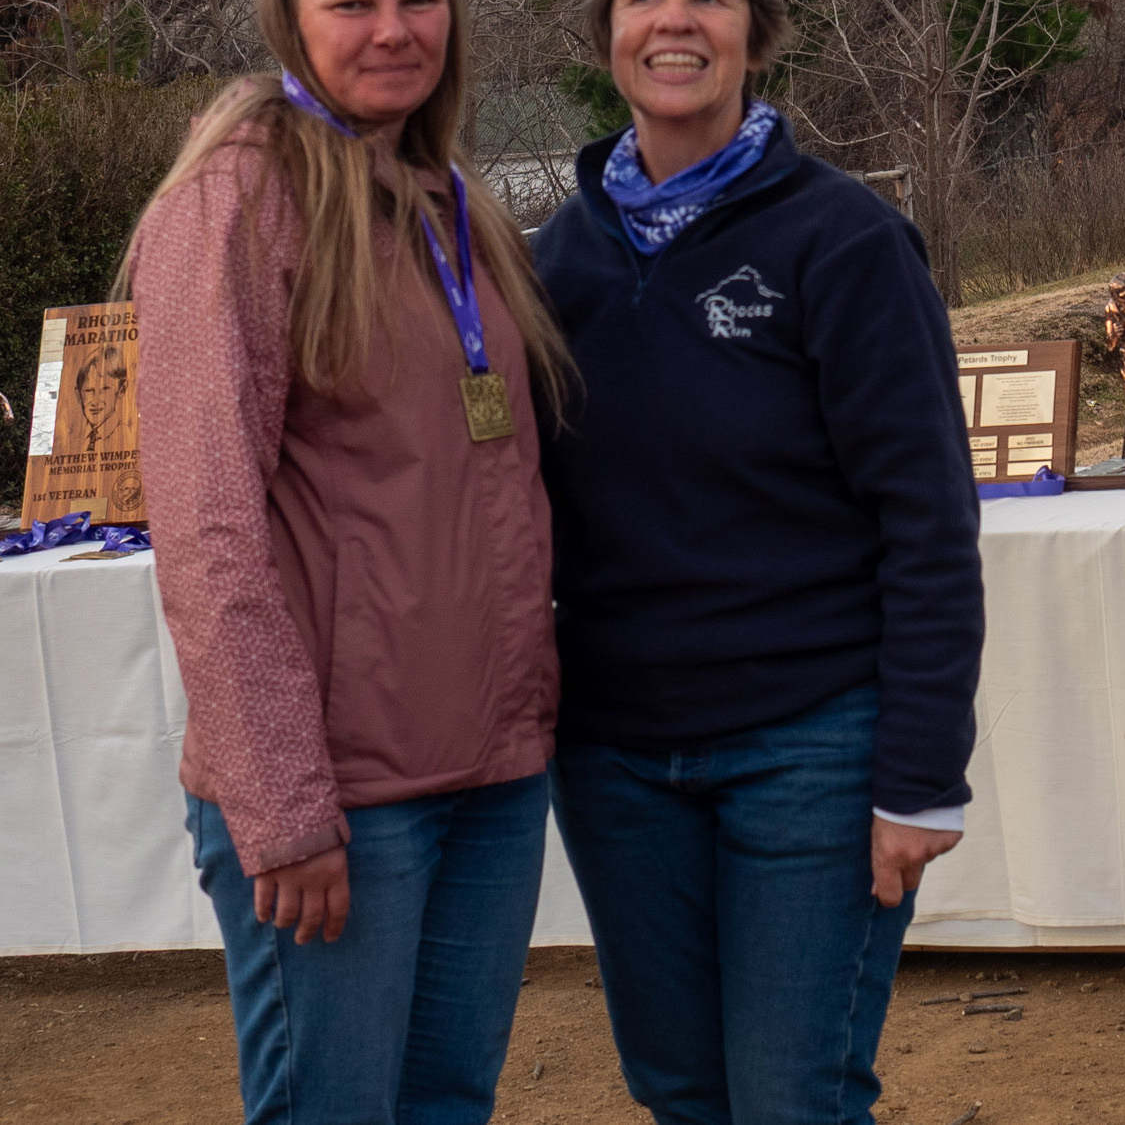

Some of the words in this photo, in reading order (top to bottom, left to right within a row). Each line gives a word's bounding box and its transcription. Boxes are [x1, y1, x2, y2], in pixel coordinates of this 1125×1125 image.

[77, 312, 138, 329] RHODES
[64, 328, 139, 347] MARATHO
[990, 354, 1017, 363] Trophy
[44, 452, 97, 466] MATTHEW
[49, 464, 97, 476] MEMORIAL
[99, 461, 138, 472] TROPHY
[48, 488, 97, 501] VETERAN
